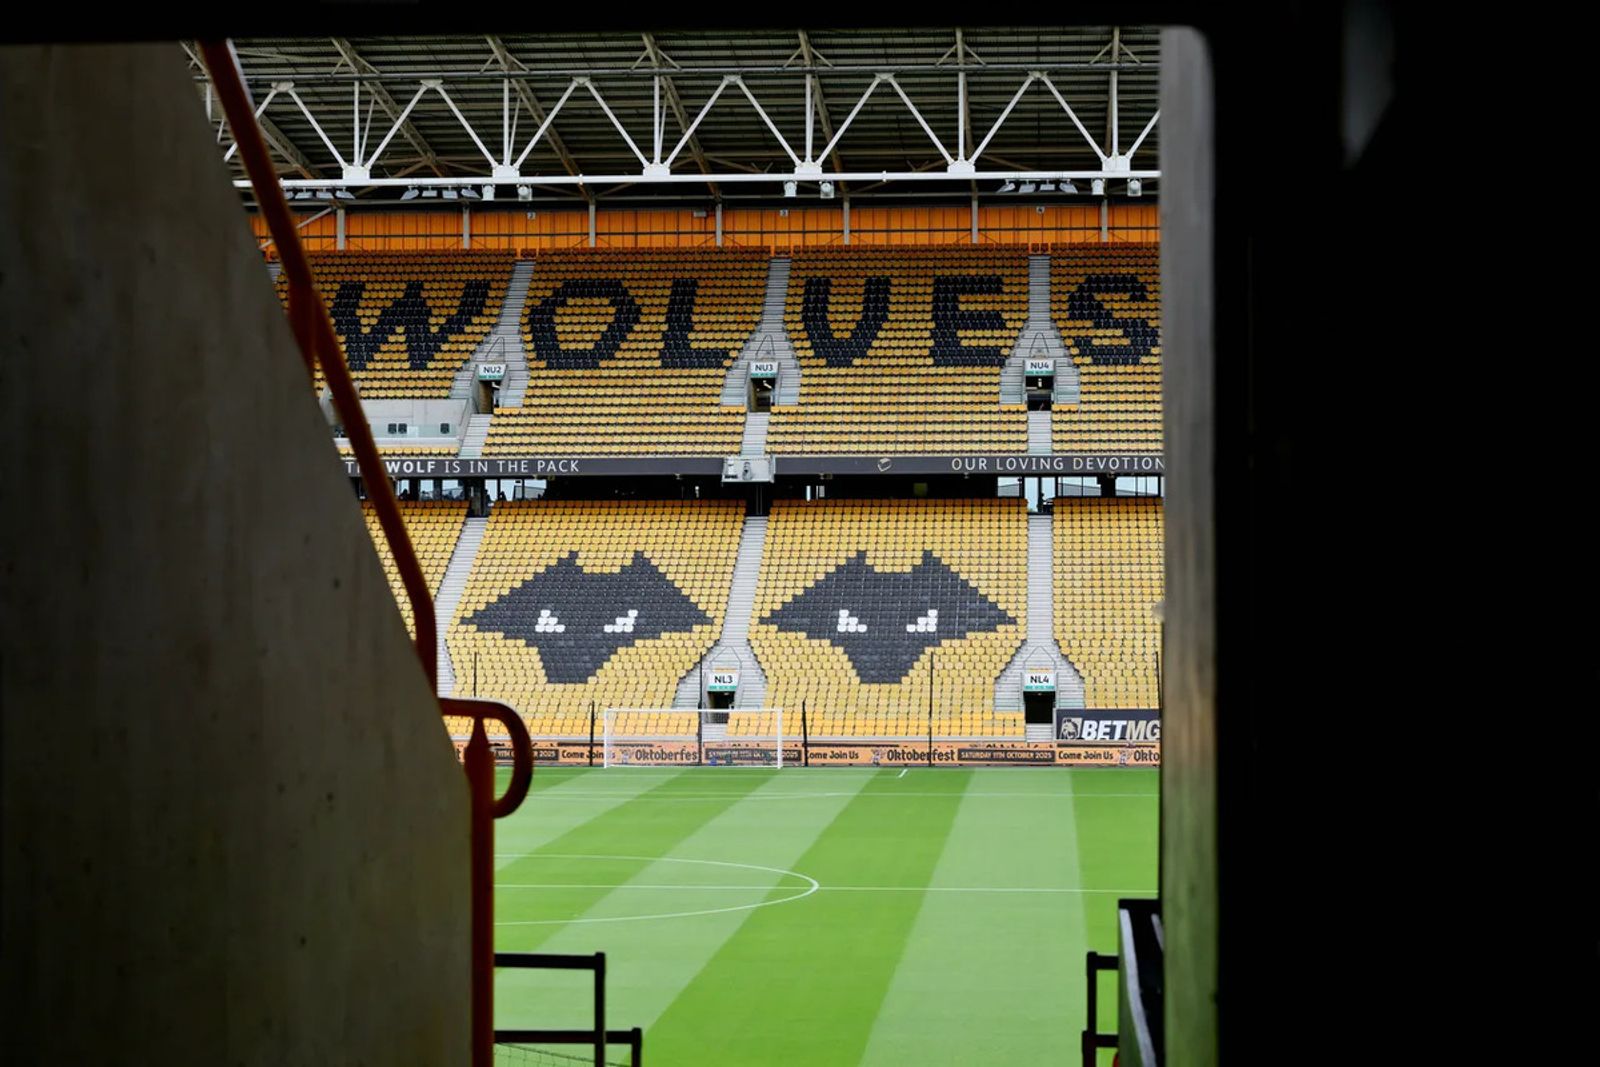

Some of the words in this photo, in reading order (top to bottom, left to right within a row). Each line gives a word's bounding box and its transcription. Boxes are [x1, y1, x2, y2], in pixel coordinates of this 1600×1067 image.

[330, 276, 1160, 369] WOLVES
[385, 461, 436, 473] WOLF
[445, 461, 460, 473] IS
[470, 460, 488, 473] IN
[498, 460, 528, 473] THE
[537, 460, 580, 472] PACK
[951, 457, 988, 470] OUR
[996, 457, 1064, 470] LOVING
[1073, 457, 1164, 470] DEVOTION
[714, 675, 733, 683] NL3
[1030, 675, 1049, 683] NL4
[562, 750, 583, 759] Come
[635, 748, 698, 761] Oktoberfes
[829, 750, 848, 759] Join
[849, 750, 859, 759] Us
[1006, 751, 1034, 759] OCTOBER
[1035, 751, 1052, 759] 2025
[1058, 750, 1082, 760] Come
[1083, 751, 1102, 760] Join
[1103, 751, 1114, 760] Us
